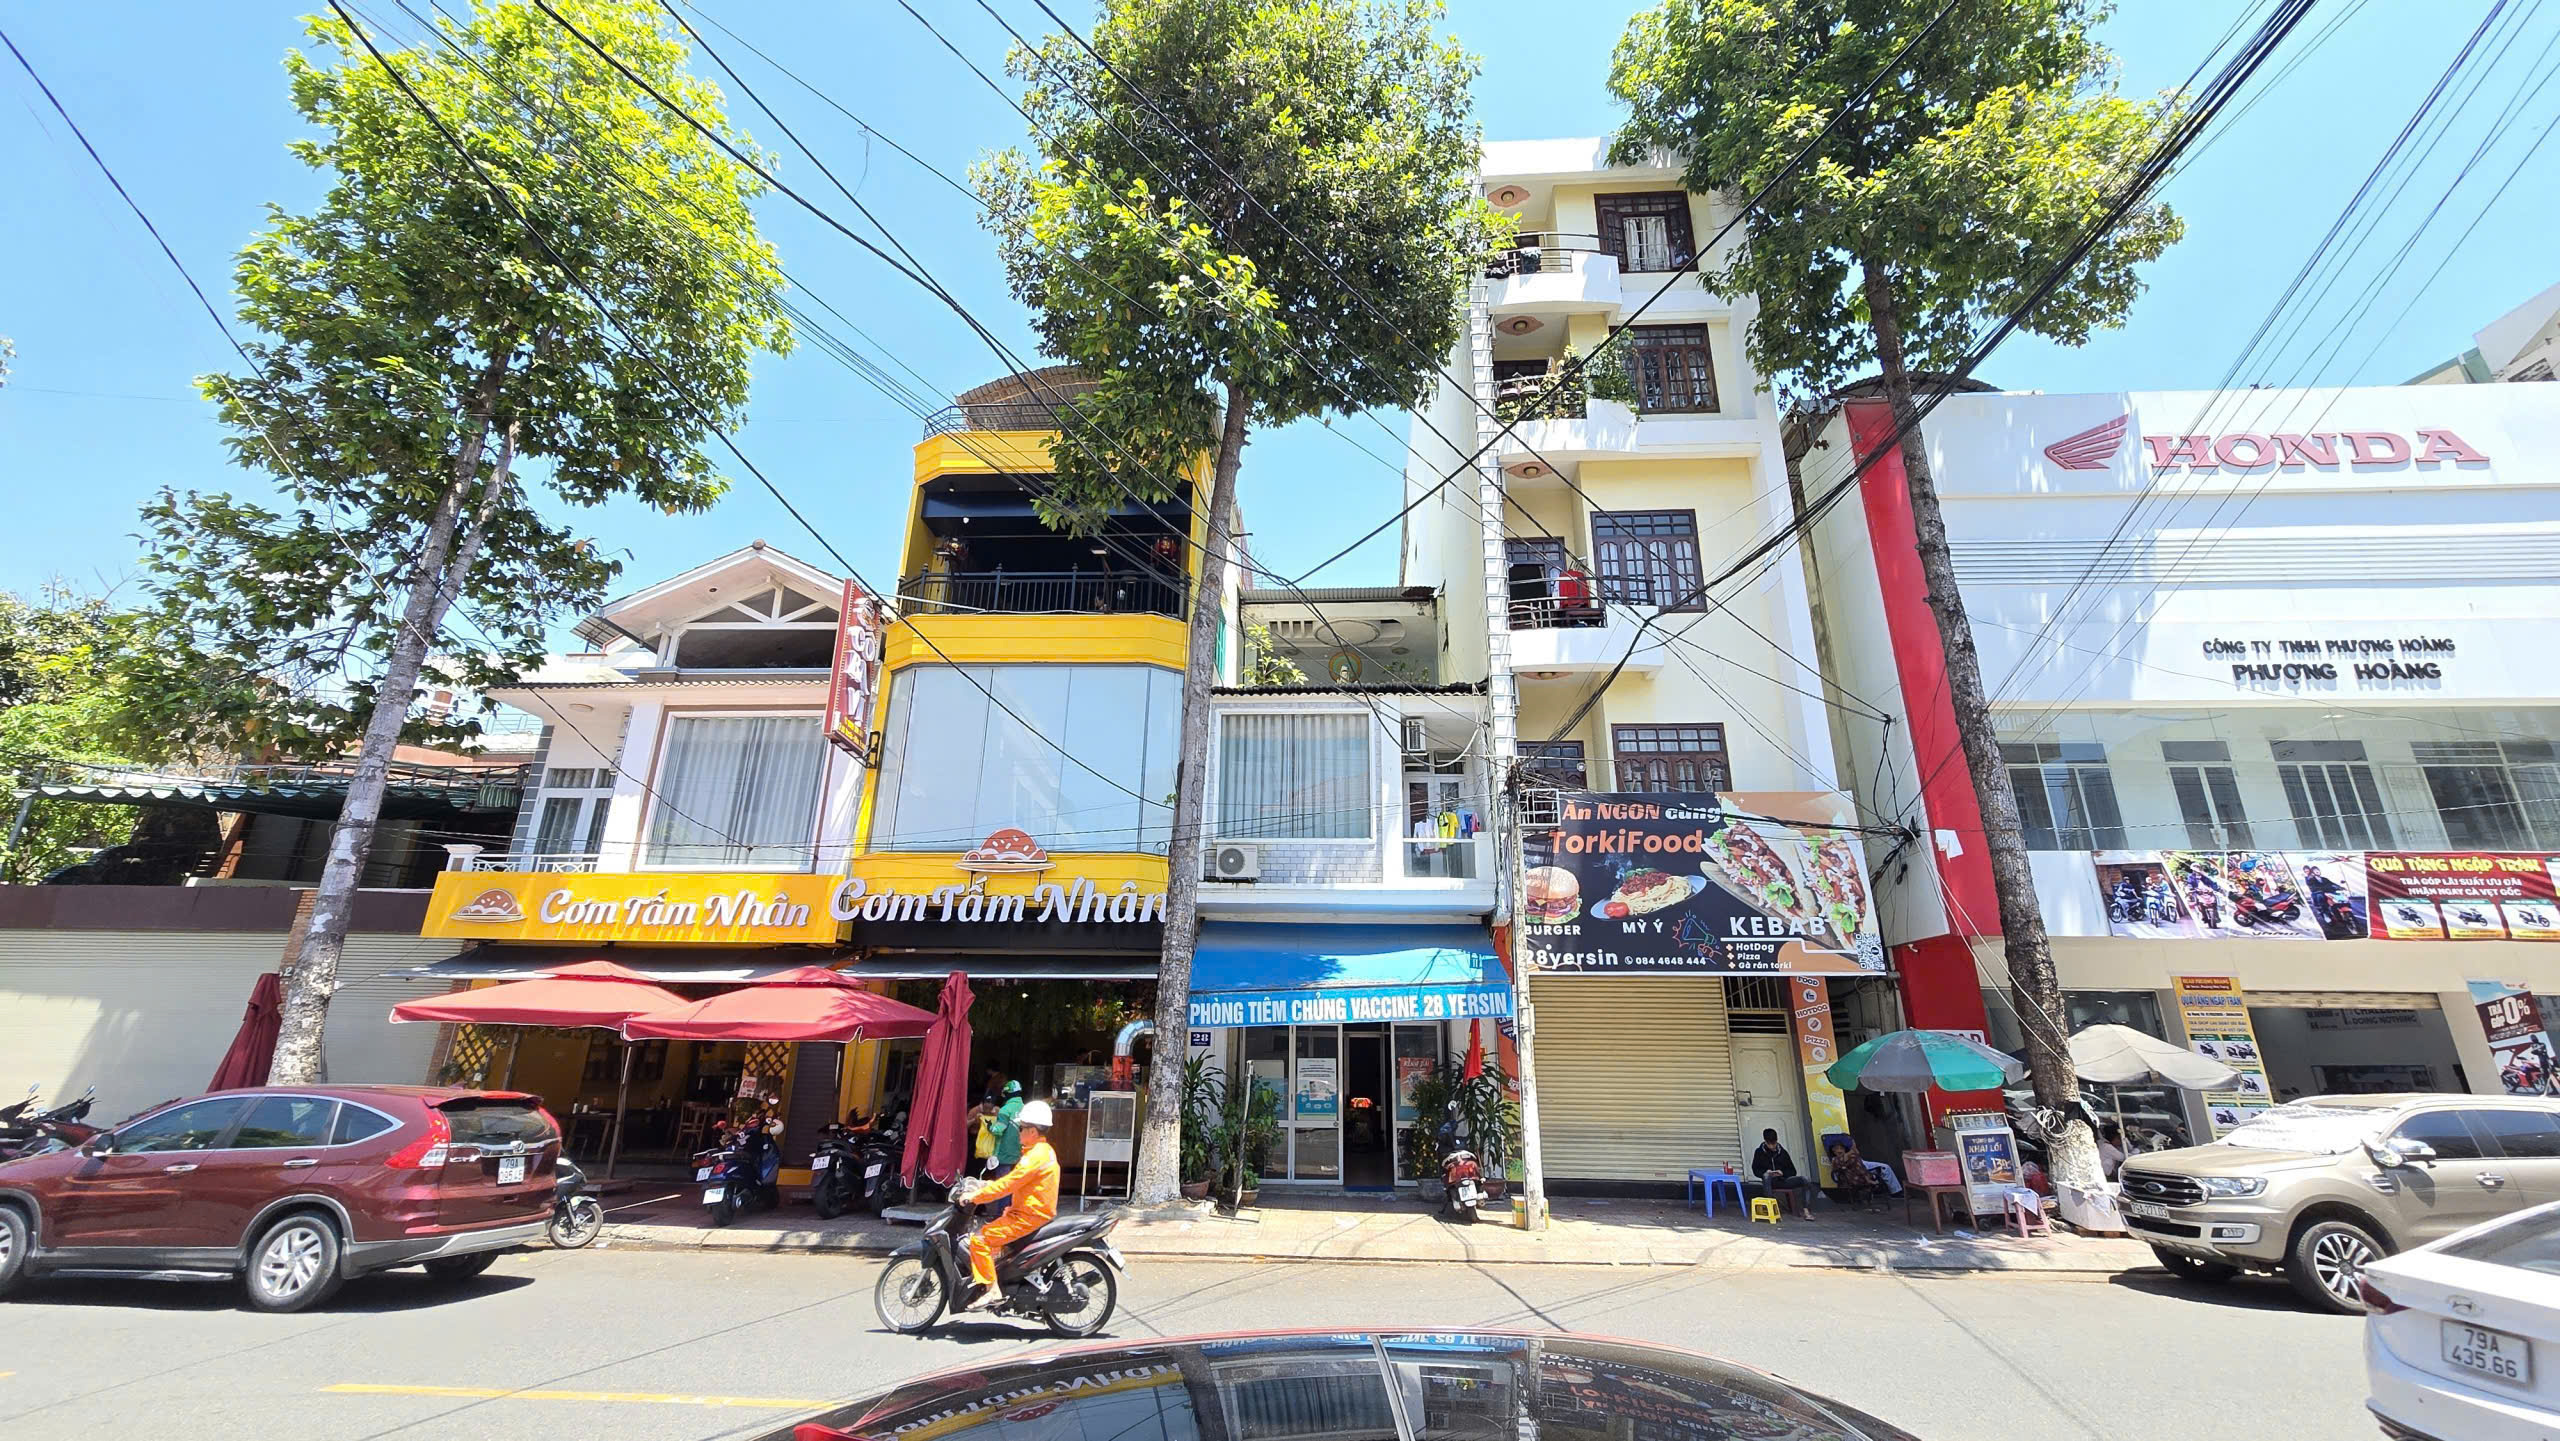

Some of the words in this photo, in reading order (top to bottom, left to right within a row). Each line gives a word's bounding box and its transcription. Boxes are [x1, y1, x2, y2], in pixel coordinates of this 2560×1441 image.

[2143, 429, 2490, 468] HONDA
[2203, 638, 2246, 653] CÔNG
[2251, 641, 2271, 653] TY
[2279, 641, 2322, 653] TNHH
[2398, 636, 2456, 652] HOÀNG
[2232, 663, 2338, 684] PHƯỢNG
[2354, 659, 2442, 680] HOÀNG
[1562, 800, 1592, 821] Ăn
[1597, 803, 1660, 820] NGON
[1665, 803, 1721, 823] cùng
[1549, 829, 1703, 854] TorkiFood
[2370, 856, 2405, 872] QUÀ
[2405, 856, 2449, 874] TẶNG
[2449, 856, 2494, 874] NGẬP
[830, 877, 927, 922] Cơm
[932, 876, 1024, 923] Tấm
[1034, 877, 1166, 923] Nhân
[2438, 888, 2463, 896] NGAY
[540, 889, 617, 925] Cơm
[624, 888, 695, 926] Tấm
[705, 889, 810, 926] Nhân
[1525, 925, 1581, 936] BURGER
[1653, 918, 1664, 934] Ý
[1731, 916, 1827, 936] KEBAB
[1736, 943, 1774, 953] HotDog
[1635, 957, 1655, 965] 084
[1658, 957, 1684, 965] 4648
[1686, 957, 1707, 965] 444
[1738, 961, 1751, 969] Gà
[1753, 961, 1769, 969] rán
[1770, 961, 1792, 969] torki
[1797, 976, 1819, 986] FOOD
[1189, 997, 1244, 1025] PHÒNG
[1248, 996, 1287, 1024] TIÊM
[1291, 991, 1347, 1022] CHỦNG
[1351, 994, 1419, 1020] VACCINE
[1423, 995, 1443, 1017] 28
[1447, 992, 1507, 1016] YERSIN
[1796, 1004, 1829, 1018] HOTDOG
[2502, 997, 2531, 1025] 0%
[1805, 1036, 1829, 1047] PIZZA
[505, 1158, 519, 1169] 79A
[2464, 1328, 2500, 1353] 79A
[2452, 1345, 2517, 1378] 435.66
